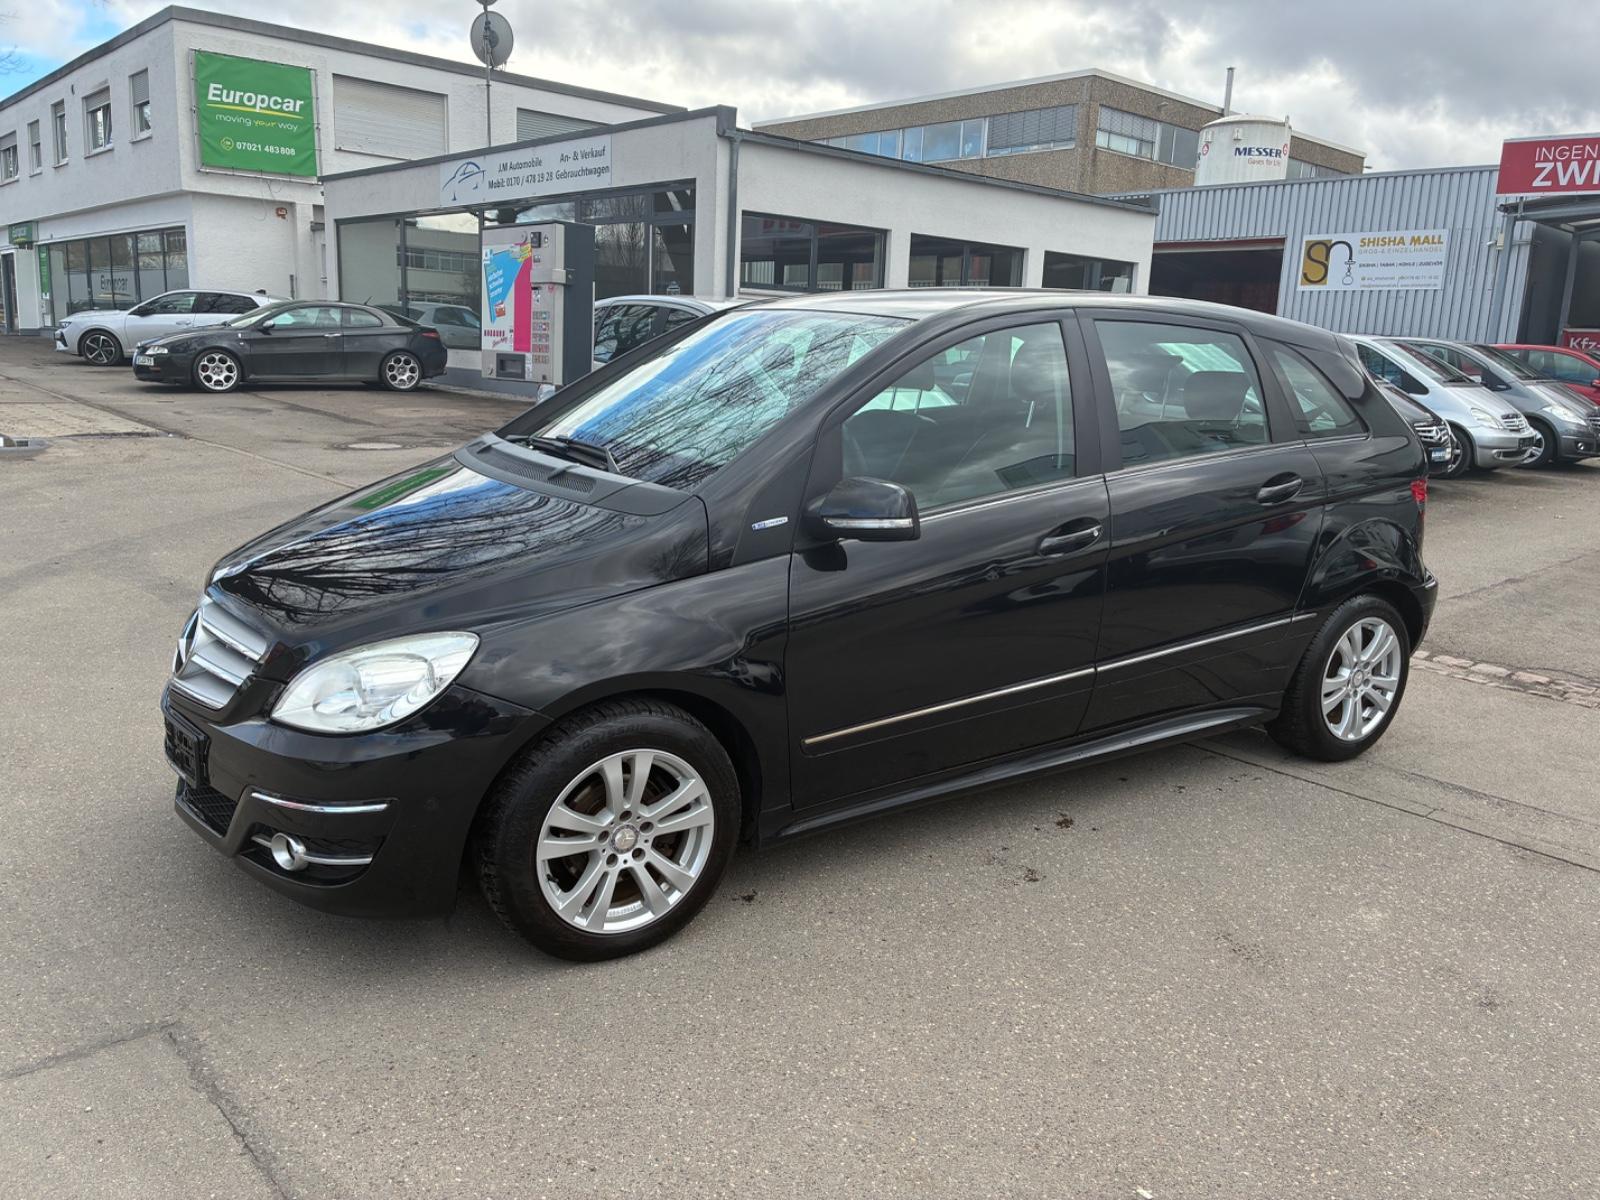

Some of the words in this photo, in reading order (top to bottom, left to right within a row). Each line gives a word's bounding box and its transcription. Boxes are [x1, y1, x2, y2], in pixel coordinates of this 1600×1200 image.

[207, 83, 305, 112] Europcar
[215, 113, 252, 127] moving
[278, 122, 298, 132] way
[236, 141, 262, 152] 07021
[1234, 147, 1282, 158] MESSER
[509, 157, 543, 172] Automobile
[560, 153, 571, 164] An-
[572, 152, 579, 161] &
[580, 146, 606, 160] Verkauf
[488, 178, 505, 190] Mobil:
[505, 175, 521, 188] 0170
[525, 173, 536, 185] 478
[555, 164, 610, 180] Gebrauchtwagen
[1359, 236, 1406, 248] SHISHA
[1409, 234, 1444, 247] MALL
[1387, 246, 1443, 255] EINZELHANDEL
